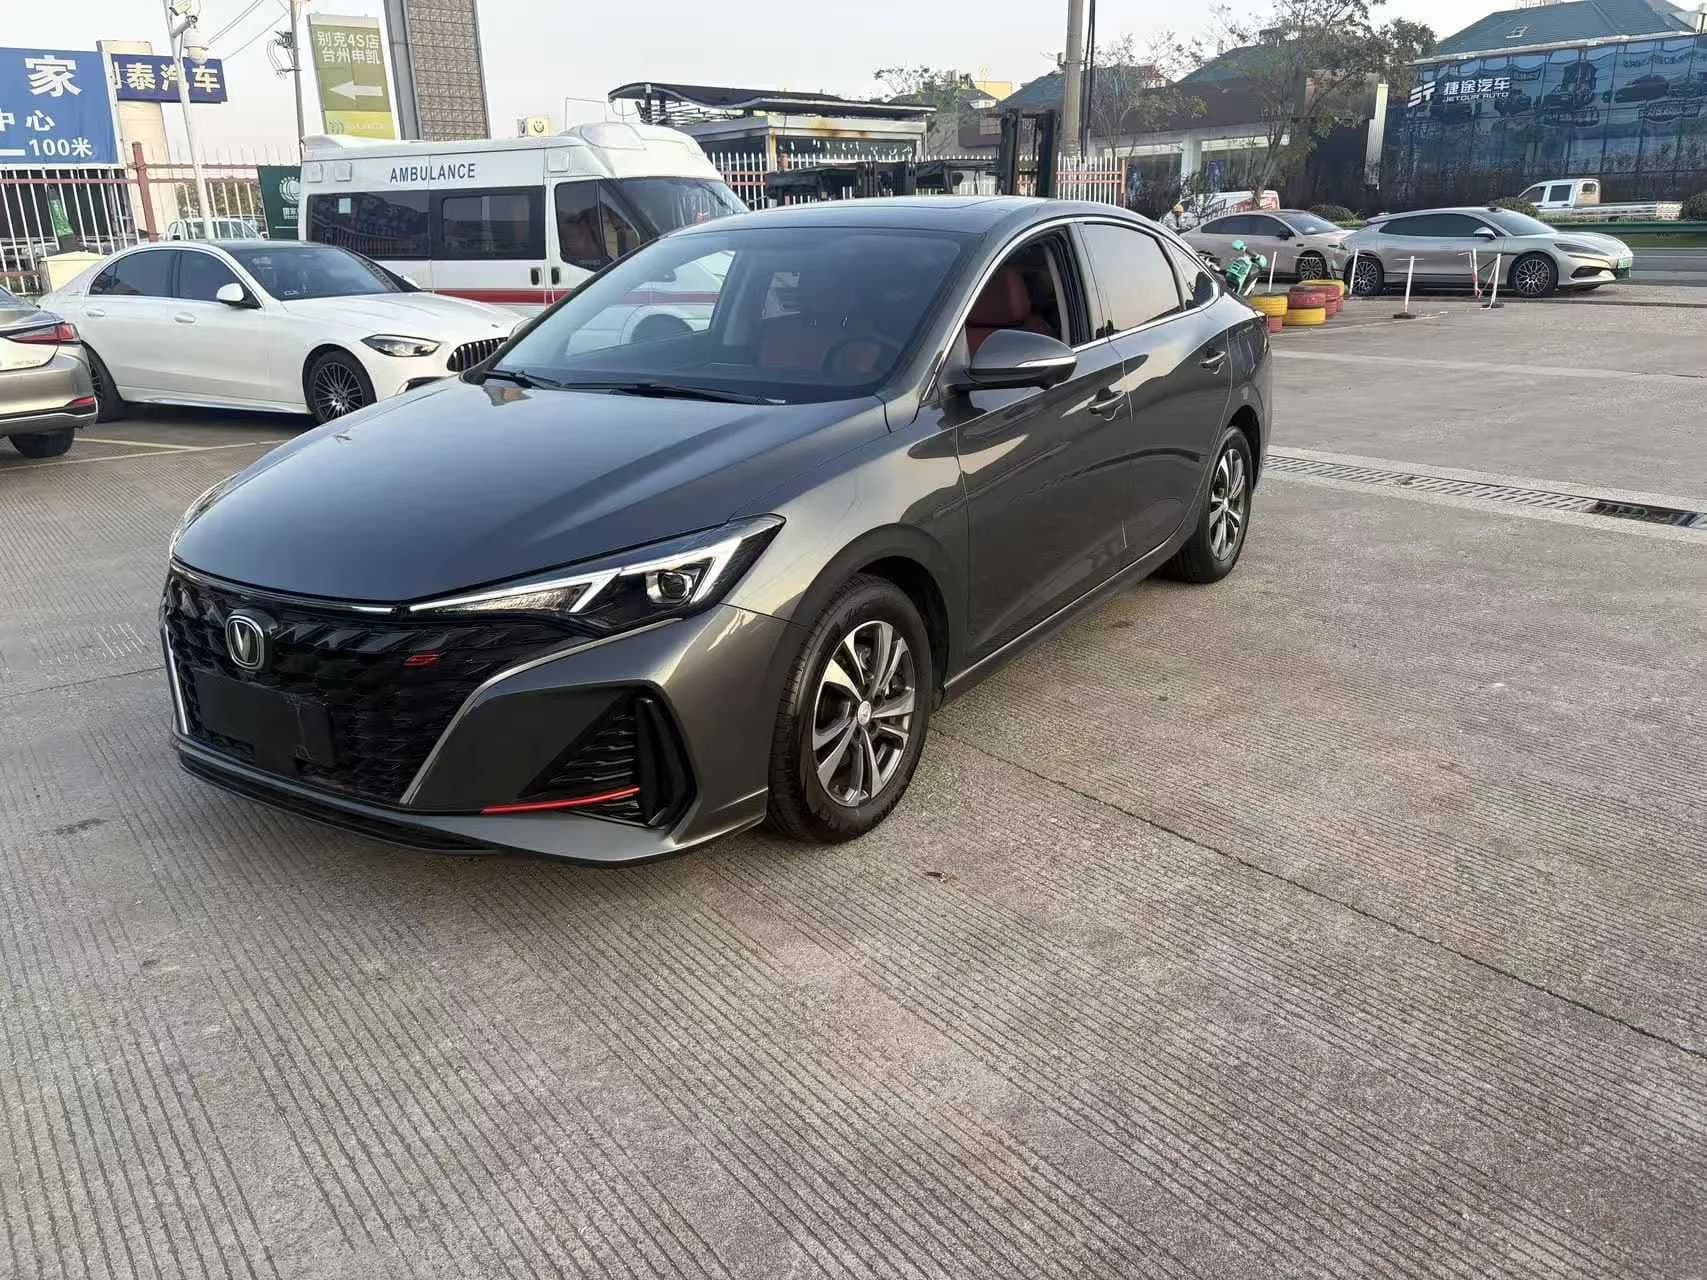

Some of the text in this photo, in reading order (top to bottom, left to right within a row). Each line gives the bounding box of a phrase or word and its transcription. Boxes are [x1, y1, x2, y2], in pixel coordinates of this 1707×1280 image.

[317, 31, 379, 49] 别克4S店
[25, 54, 82, 97] 家
[1443, 77, 1510, 96] 捷途汽车
[1442, 94, 1479, 102] JETOUR
[28, 137, 93, 158] 100米
[390, 163, 476, 183] AMBULANCE
